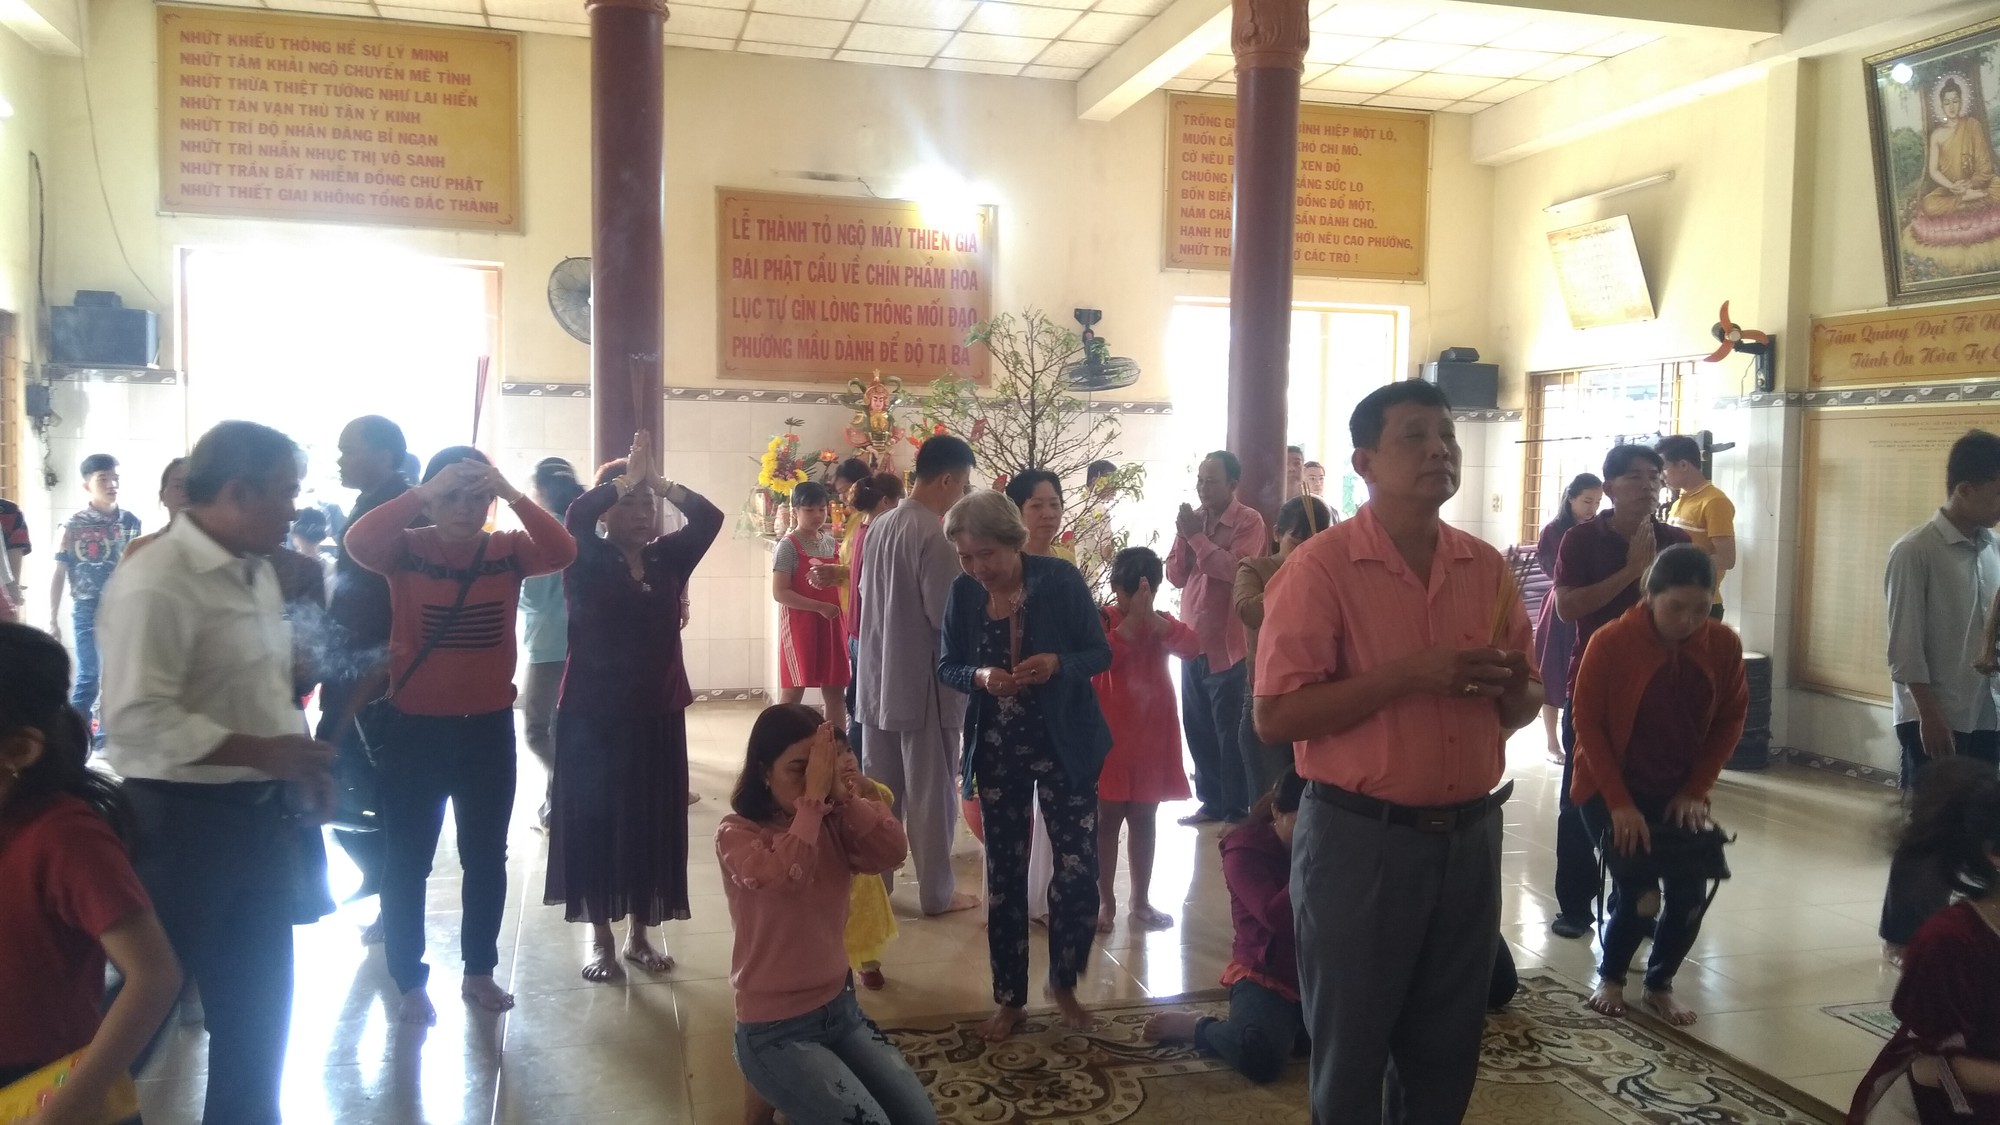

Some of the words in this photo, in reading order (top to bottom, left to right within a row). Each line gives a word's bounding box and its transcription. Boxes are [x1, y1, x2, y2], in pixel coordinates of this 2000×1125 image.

[411, 48, 449, 64] MINH
[415, 90, 437, 105] LAI
[385, 109, 421, 125] KINH
[1323, 122, 1350, 138] HIỆP
[1352, 124, 1376, 140] MỘT
[1182, 130, 1216, 146] MUỐN
[1319, 142, 1339, 154] CHI
[406, 153, 445, 169] SANH
[1301, 159, 1322, 171] XEN
[1181, 170, 1228, 184] CHUÔNG
[1349, 180, 1364, 192] LO
[278, 188, 308, 203] GIAI
[1181, 185, 1205, 201] BỐN
[1209, 207, 1232, 221] CHÂ
[1352, 216, 1378, 229] CHO.
[732, 207, 750, 241] LỄ
[756, 214, 808, 244] THÀNH
[812, 216, 832, 245] TỎ
[837, 218, 866, 251] NGỘ
[871, 219, 903, 249] MÁY
[1180, 226, 1211, 240] HẠNH
[1343, 235, 1364, 247] CAO
[732, 250, 758, 280] BÁI
[763, 253, 802, 286] PHẬT
[808, 249, 837, 284] CẦU
[842, 251, 860, 285] VỀ
[866, 258, 900, 287] CHÍN
[904, 255, 946, 289] PHẨM
[950, 268, 978, 291] HOA
[732, 297, 761, 324] LỤC
[766, 297, 787, 325] TỰ
[792, 293, 816, 322] GÌN
[820, 294, 860, 324] LÒNG
[864, 296, 913, 326] THÔNG
[916, 293, 944, 327] MỐI
[948, 306, 977, 333] ĐẠO
[732, 335, 792, 360] PHƯƠNG
[797, 327, 830, 361] MẦU
[834, 333, 874, 363] DÀNH
[880, 330, 900, 364] ĐỂ
[904, 336, 924, 369] ĐỘ
[928, 343, 947, 365] TA
